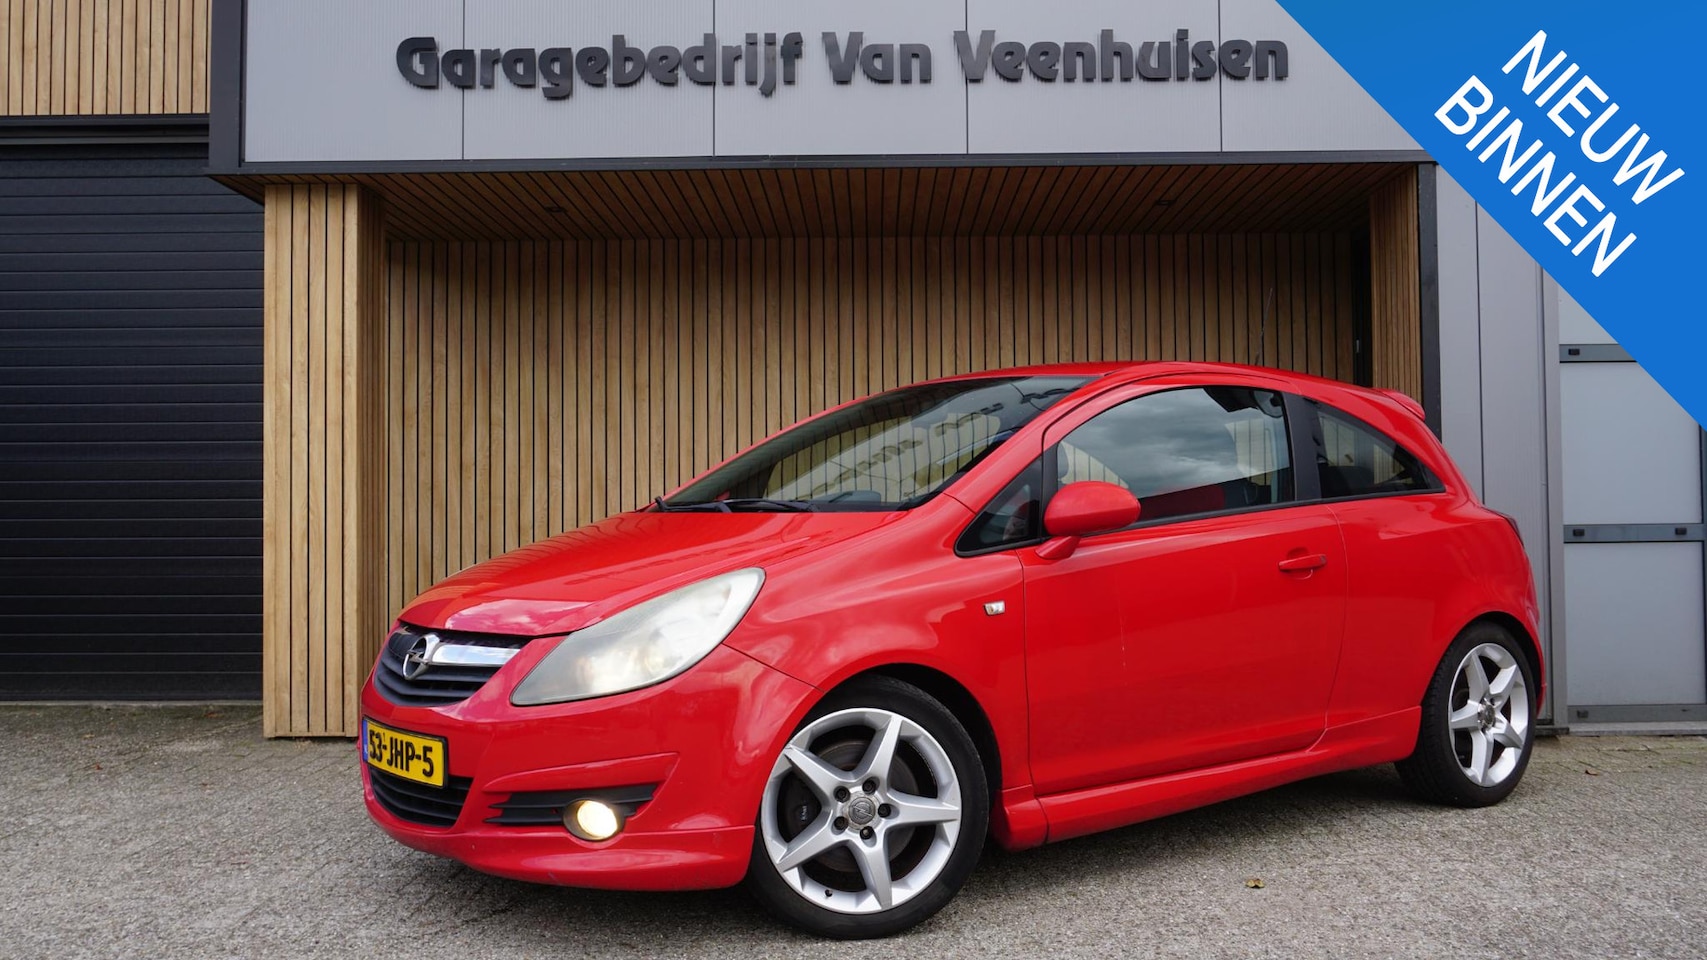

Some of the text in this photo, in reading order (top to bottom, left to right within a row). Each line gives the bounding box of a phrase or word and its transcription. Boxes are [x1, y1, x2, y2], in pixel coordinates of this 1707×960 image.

[396, 29, 1290, 99] Garagebedrijf Van Veenhuisen
[369, 729, 434, 778] 53-JHP-5
